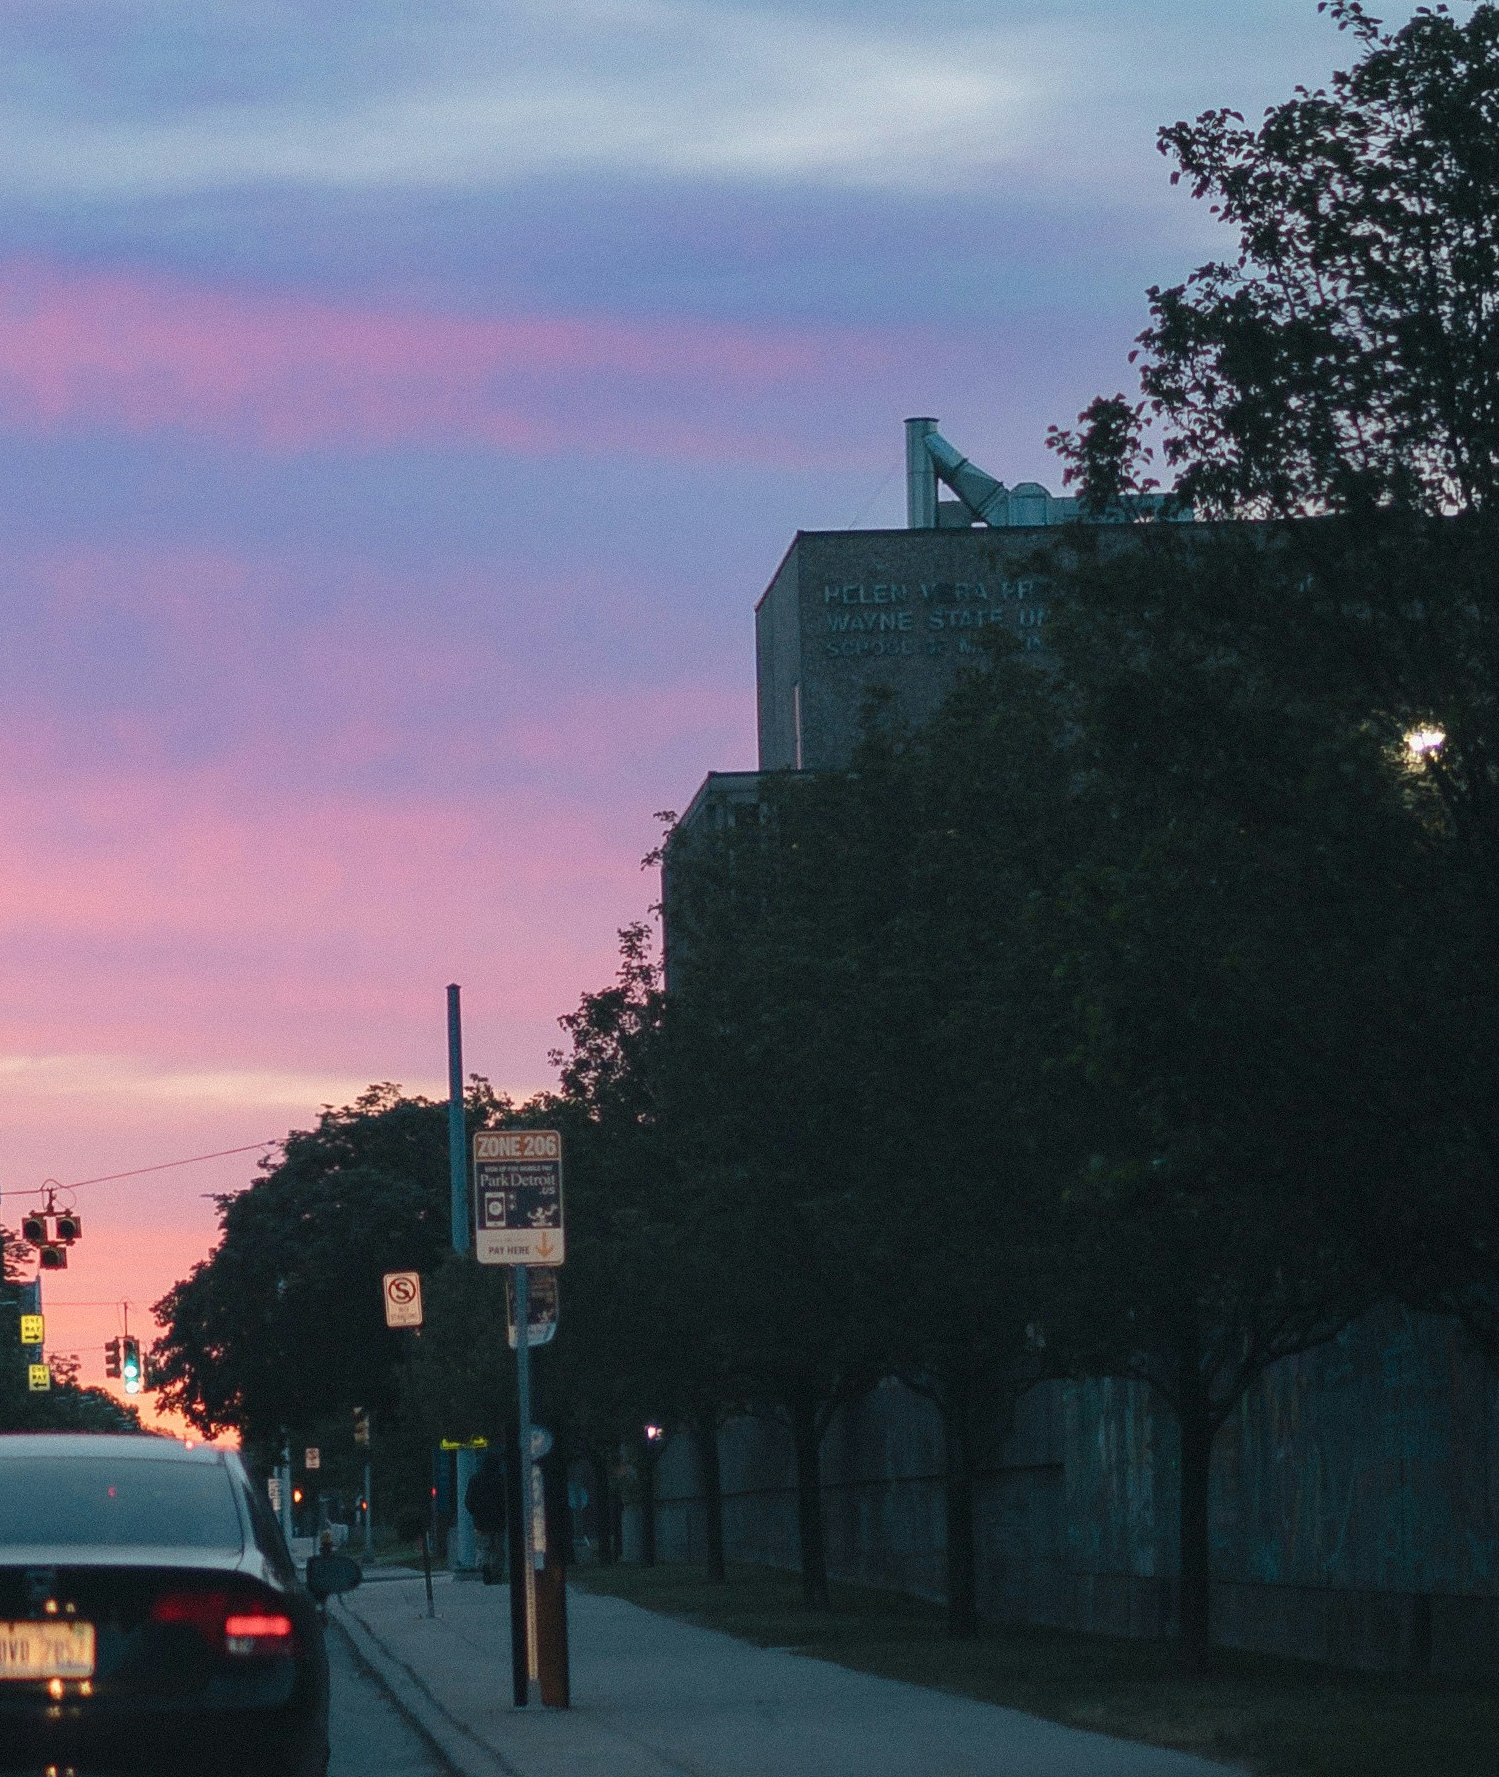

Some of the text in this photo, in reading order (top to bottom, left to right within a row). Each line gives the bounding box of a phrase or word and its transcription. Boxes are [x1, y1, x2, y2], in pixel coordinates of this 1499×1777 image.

[823, 584, 907, 604] HELEN
[826, 610, 913, 632] WAYNE
[928, 608, 1004, 630] STATE
[477, 1134, 557, 1158] ZONE 206
[488, 1246, 530, 1255] PAY HERE
